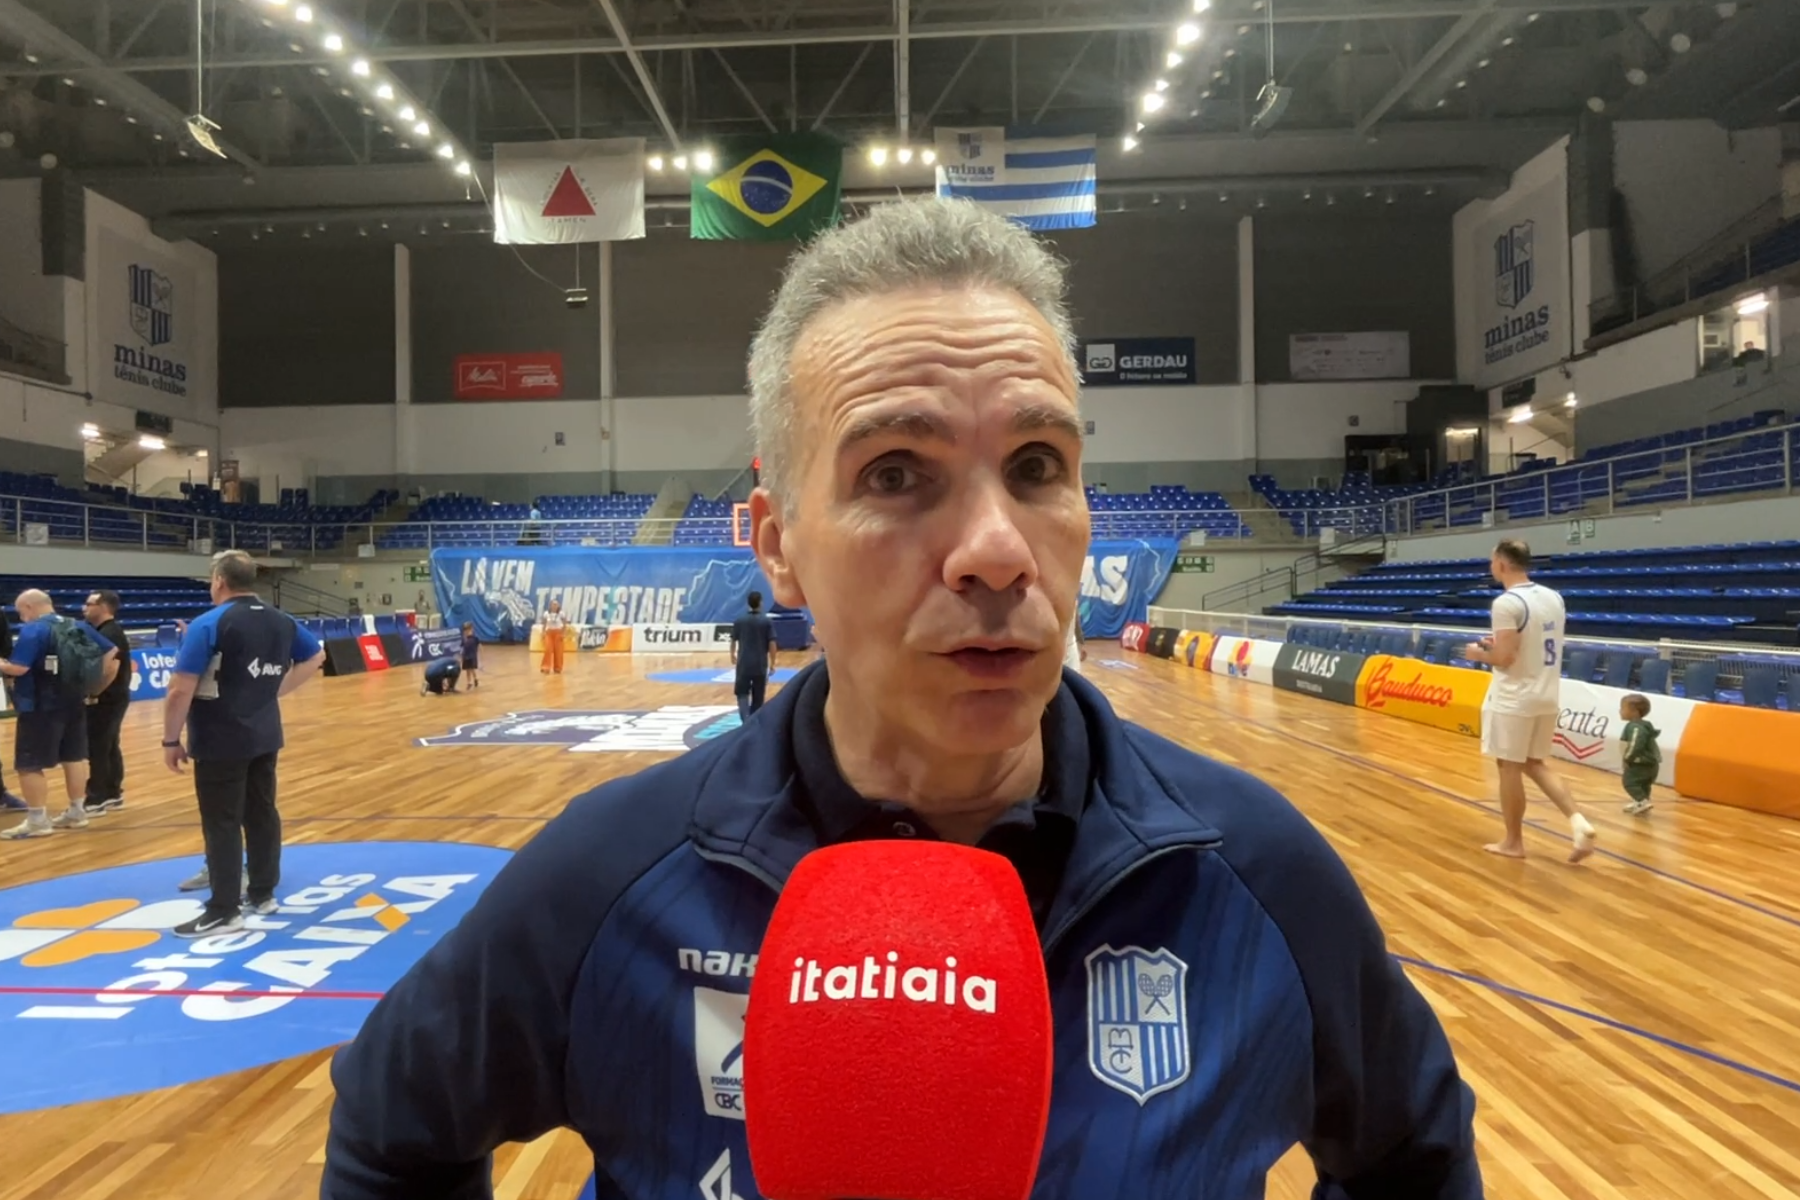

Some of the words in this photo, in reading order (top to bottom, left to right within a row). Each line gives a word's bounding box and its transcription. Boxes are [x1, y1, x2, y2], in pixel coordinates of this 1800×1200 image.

[1485, 304, 1549, 349] minas
[114, 343, 187, 382] minas
[1119, 355, 1187, 368] GERDAU
[151, 376, 187, 397] clube
[643, 626, 702, 643] trium
[141, 652, 177, 669] lote
[1291, 649, 1341, 678] LAMAS
[1365, 656, 1453, 708] Bauducco
[181, 873, 479, 1021] CAIXA
[789, 951, 997, 1014] itatiaia
